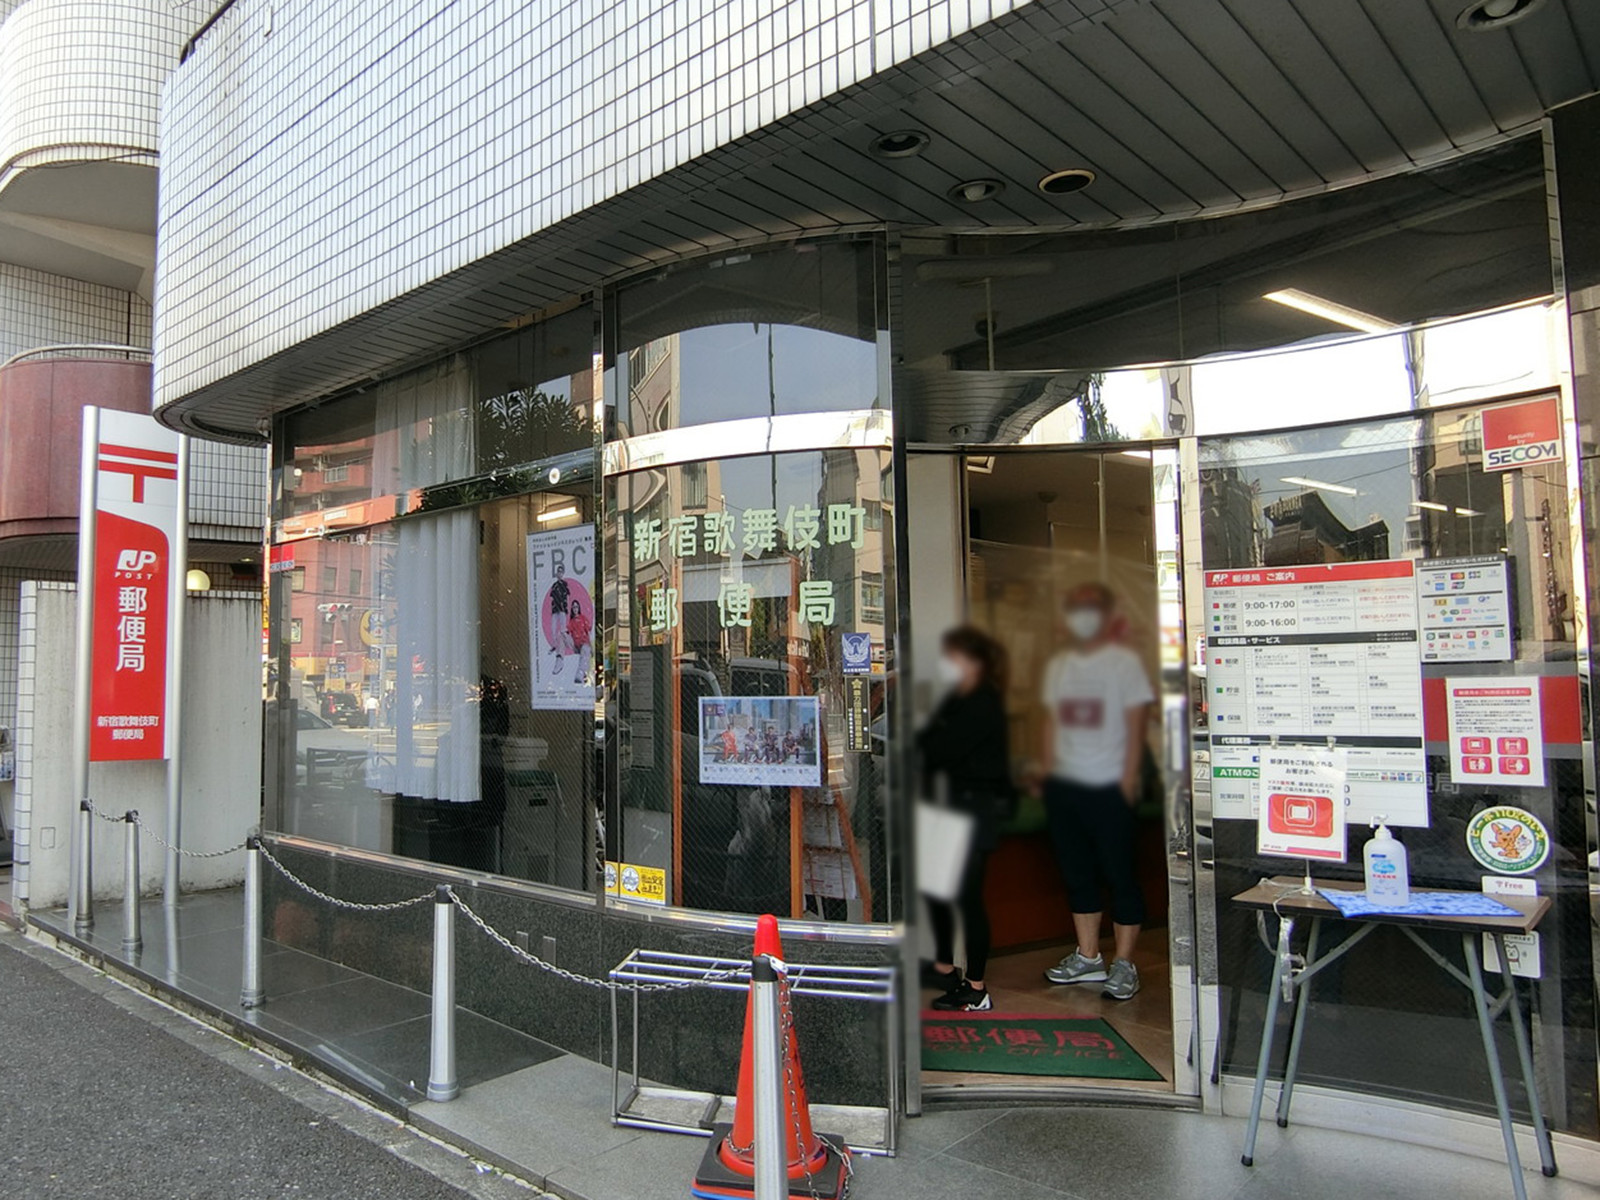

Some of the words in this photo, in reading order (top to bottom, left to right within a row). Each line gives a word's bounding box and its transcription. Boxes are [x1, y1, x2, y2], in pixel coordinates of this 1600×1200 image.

[1488, 442, 1557, 466] SECOM
[632, 503, 867, 562] 新宿歌舞伎町
[116, 549, 157, 571] JP
[532, 545, 587, 581] FBC
[114, 571, 154, 580] POST
[1232, 574, 1261, 583] 郵便局
[1266, 572, 1295, 581] ご案内
[650, 580, 836, 631] 郵便局
[1244, 600, 1296, 610] 9:00-17:00
[116, 586, 148, 672] 郵便局
[1245, 618, 1296, 627] 9:00-16:00
[97, 715, 159, 727] 新宿歌舞伎町
[112, 728, 144, 740] 郵便局
[922, 1026, 1116, 1050] 郵便局
